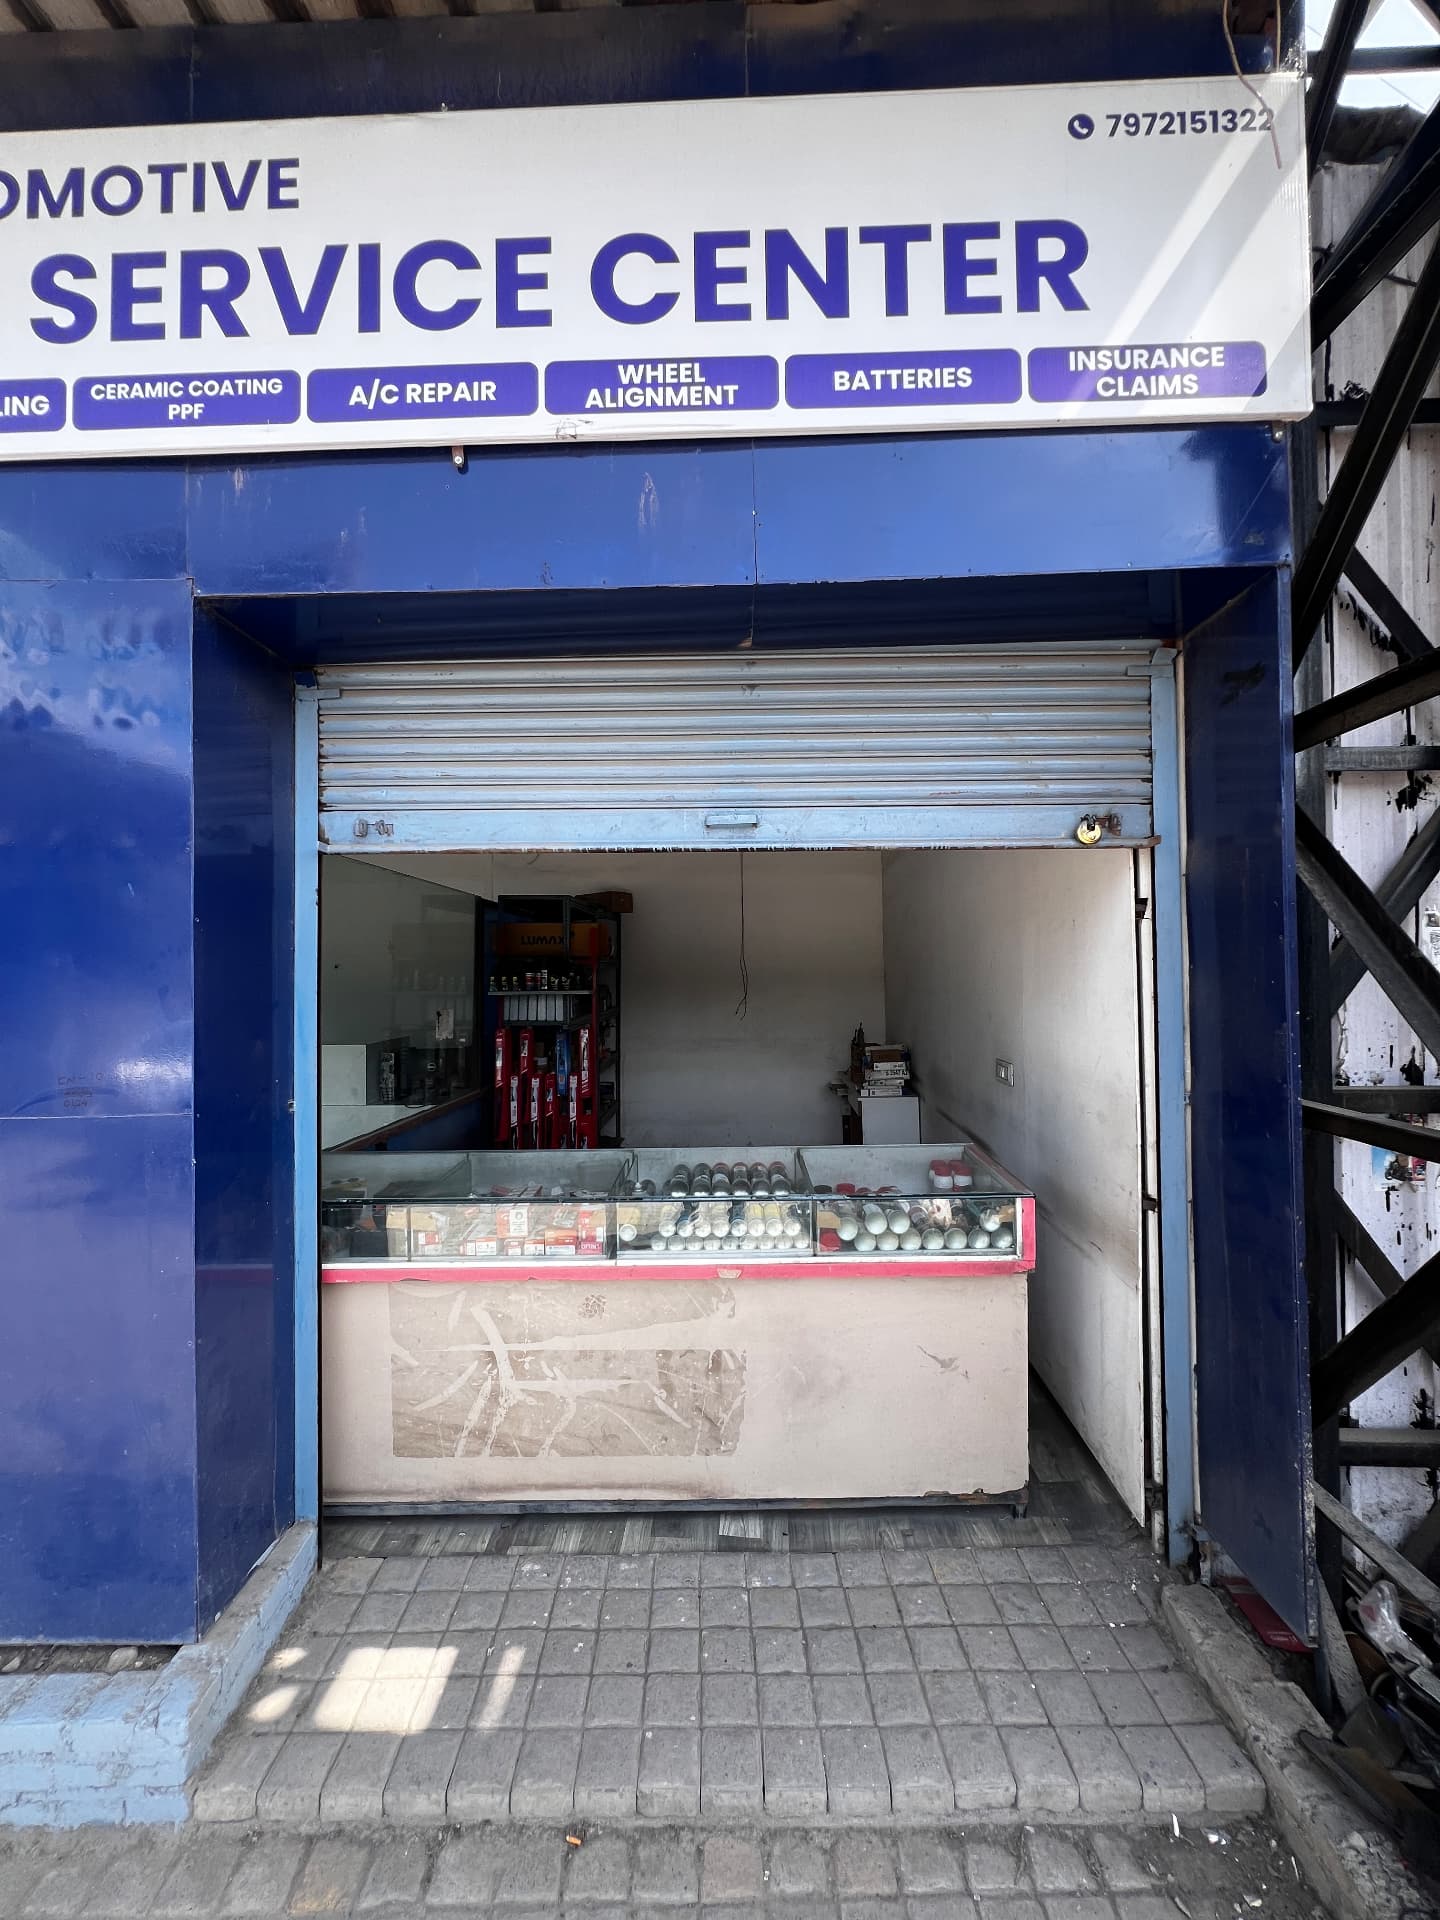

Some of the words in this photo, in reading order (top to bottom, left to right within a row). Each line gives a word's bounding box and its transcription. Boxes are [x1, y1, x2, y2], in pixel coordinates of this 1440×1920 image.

[1106, 107, 1274, 137] 7972151322
[30, 236, 552, 344] SERVICE
[590, 219, 1090, 325] CENTER
[1069, 346, 1225, 371] INSURANCE
[617, 362, 706, 385] WHEEL
[833, 366, 973, 391] BATTERIES
[1096, 373, 1199, 397] CLAIMS
[90, 381, 184, 400] CERAMIC
[188, 378, 283, 397] COATING
[349, 379, 400, 410] A/C
[406, 381, 497, 404] REPAIR
[585, 385, 739, 410] ALIGNMENT
[0, 395, 50, 417] ING
[168, 403, 205, 420] PPF
